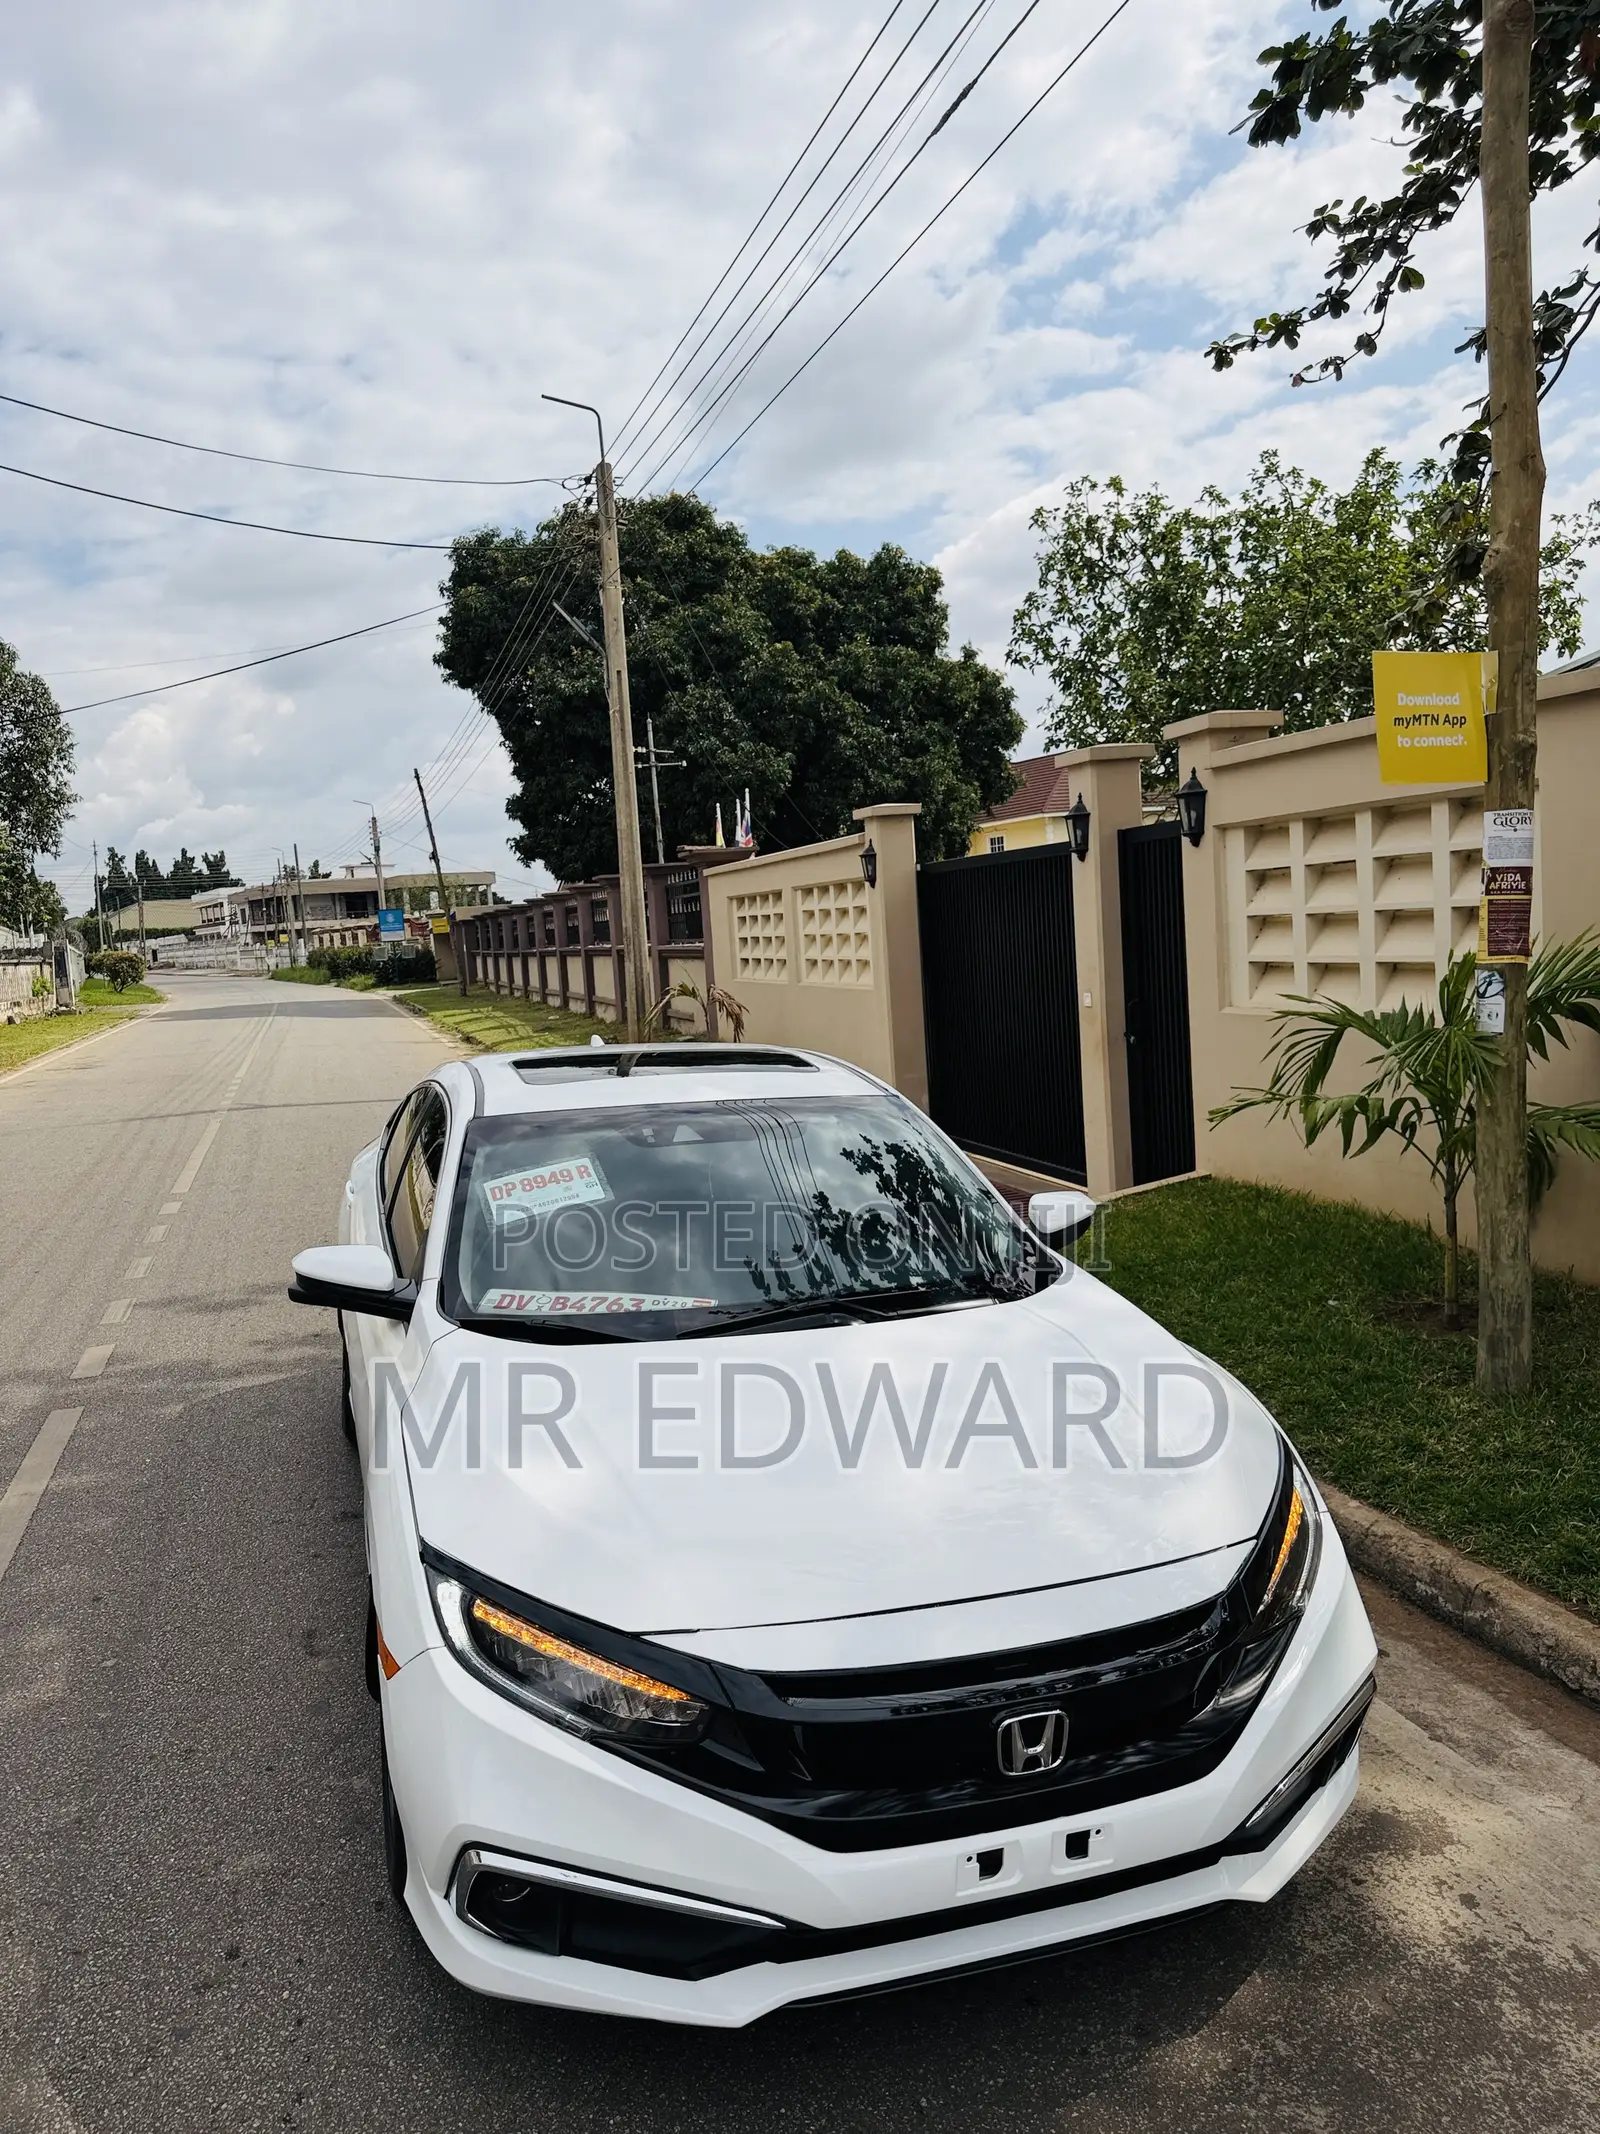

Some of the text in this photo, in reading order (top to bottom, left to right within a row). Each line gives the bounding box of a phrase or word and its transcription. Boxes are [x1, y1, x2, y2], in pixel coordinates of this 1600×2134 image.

[1397, 692, 1460, 707] Download
[1393, 714, 1467, 729] myMTN App
[1397, 733, 1467, 748] to connect.
[1493, 817, 1532, 827] GLORY
[518, 1167, 575, 1192] 8949
[575, 1164, 592, 1179] R
[493, 1294, 536, 1310] DV
